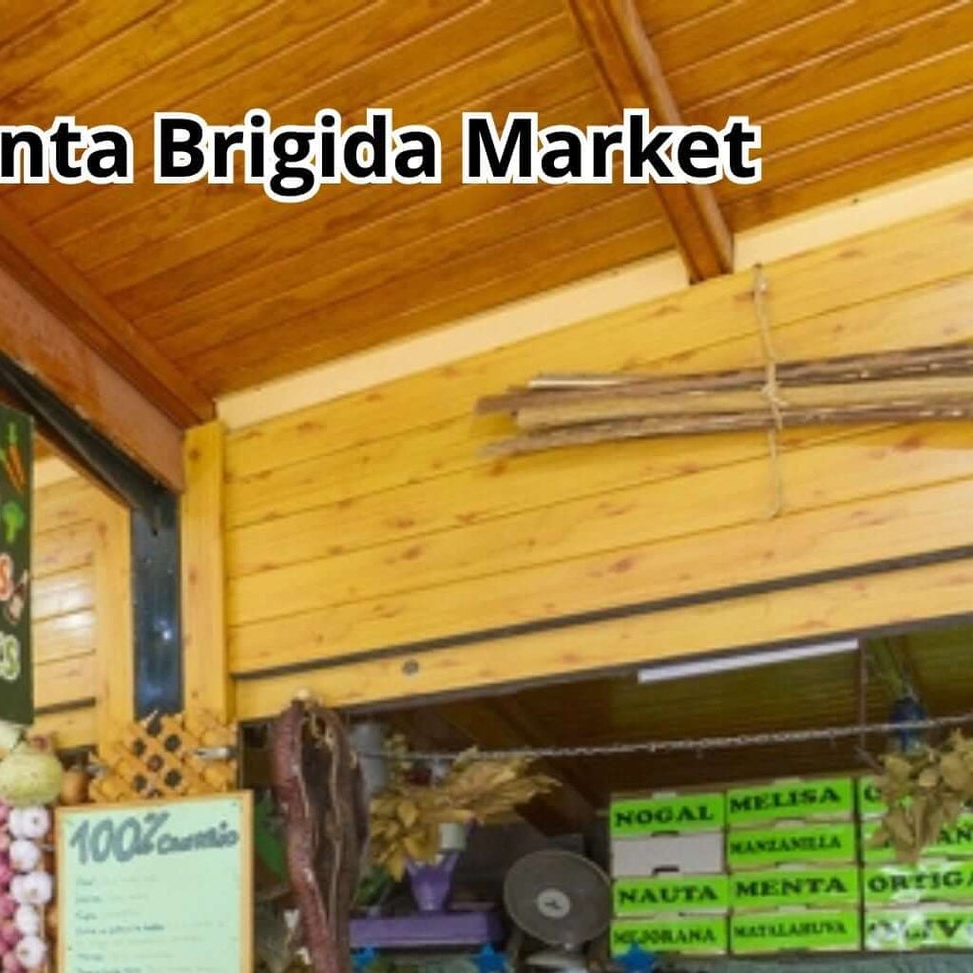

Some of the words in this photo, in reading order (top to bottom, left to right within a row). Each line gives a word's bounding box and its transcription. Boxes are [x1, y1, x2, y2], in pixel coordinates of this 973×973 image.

[729, 787, 842, 813] MELISA
[615, 805, 715, 828] NOGAL
[617, 884, 719, 906] NAUTA
[735, 876, 848, 898] MENTA
